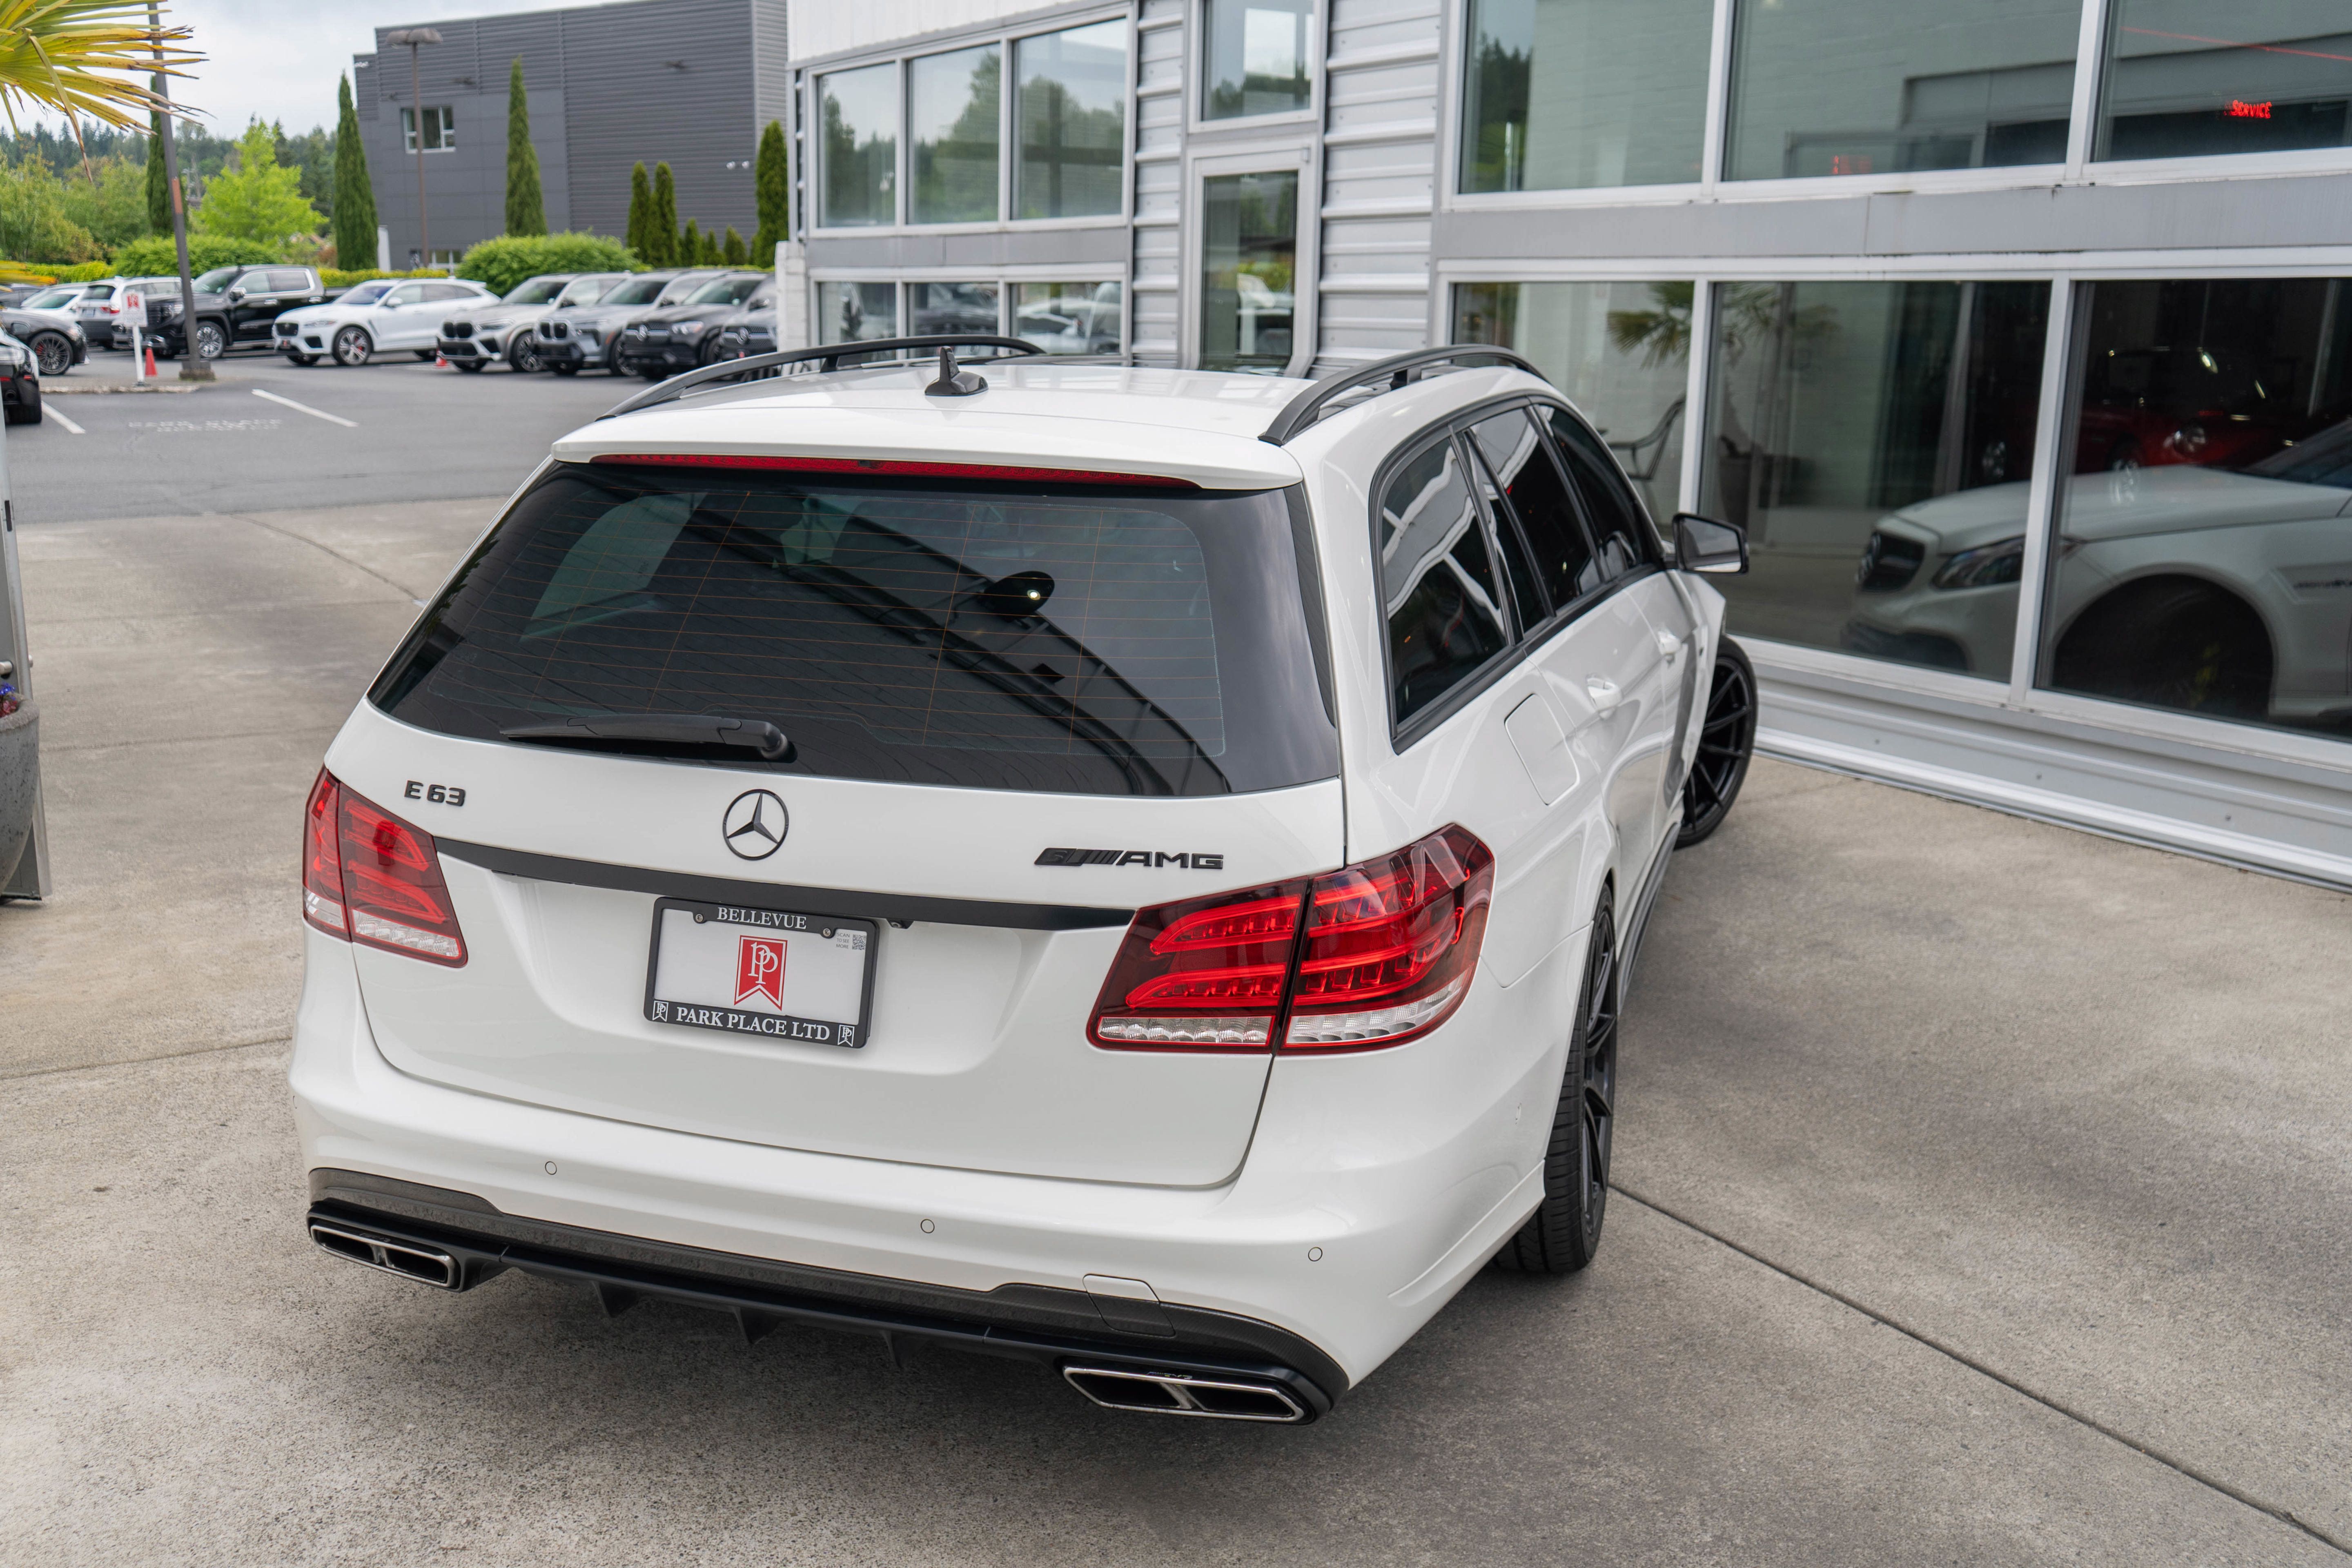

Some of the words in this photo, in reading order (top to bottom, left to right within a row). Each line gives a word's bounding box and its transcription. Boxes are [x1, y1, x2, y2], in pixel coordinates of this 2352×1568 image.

[2231, 100, 2272, 118] SERVICE
[1116, 851, 1224, 869] AMG
[717, 907, 807, 930] BELLEVUE
[676, 1007, 724, 1027] PARK
[727, 1013, 787, 1035] PLACE
[791, 1022, 830, 1041] LTD
